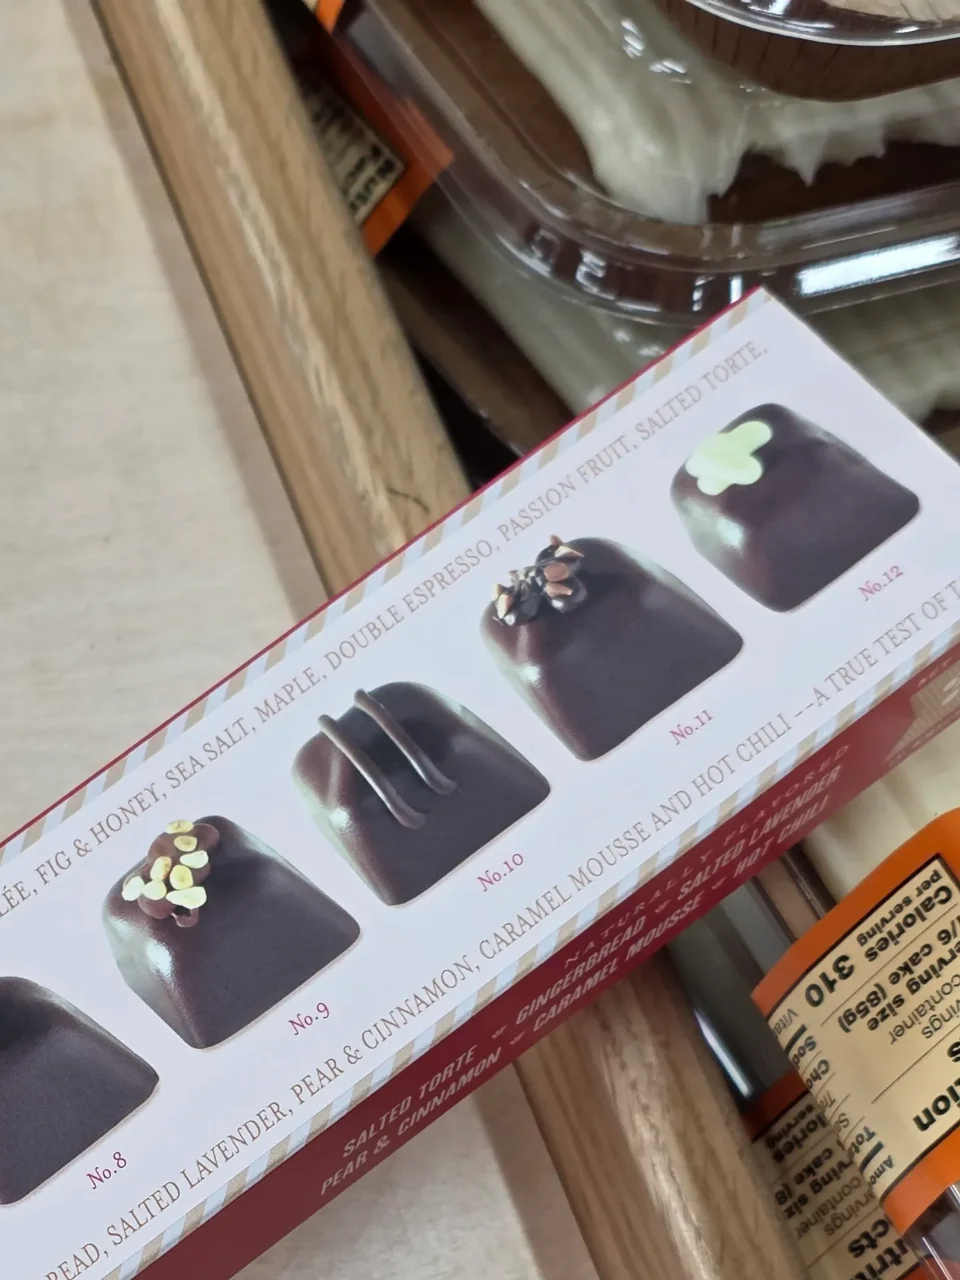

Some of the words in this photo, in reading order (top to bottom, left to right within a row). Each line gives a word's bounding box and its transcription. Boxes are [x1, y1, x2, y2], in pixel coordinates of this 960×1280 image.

[857, 565, 904, 601] No.12
[34, 850, 72, 886] FIG
[72, 838, 92, 857] &
[89, 783, 167, 845] HONEY,
[165, 756, 205, 788] SEA
[202, 718, 256, 762] SALT,
[253, 668, 327, 725] MAPLE,
[324, 608, 404, 671] DOUBLE
[402, 539, 501, 614] ESPRESSO,
[497, 475, 577, 542] PASSION
[576, 436, 639, 484] FRUIT,
[635, 385, 702, 441] SALTED
[699, 341, 768, 397] TORTE,
[668, 709, 713, 745] No.11
[476, 853, 524, 892] No.10
[915, 869, 943, 897] per
[106, 1180, 181, 1246] SALTED
[180, 1101, 294, 1189] LAVENDER,
[290, 1058, 344, 1105] PEAR
[344, 1045, 362, 1065] &
[360, 954, 480, 1050] CINNAMON,
[479, 885, 572, 960] CARAMEL
[569, 822, 651, 891] MOUSSE
[650, 790, 692, 832] AND
[691, 754, 735, 796] HOT
[735, 713, 793, 763] CHILI
[824, 647, 878, 694] TRUE
[873, 613, 921, 657] TEST
[921, 592, 948, 620] OF
[856, 896, 913, 947] serving
[864, 885, 952, 962] Calories
[343, 1096, 412, 1158] SALTED
[418, 1044, 477, 1099] TORTE
[515, 915, 648, 1026] GINGERBREAD
[677, 838, 746, 901] SALTED
[749, 764, 843, 846] LAVENDER
[805, 955, 854, 1007] 310
[888, 943, 933, 986] cake
[288, 1002, 330, 1035] No.9
[320, 1150, 368, 1196] PEAR
[374, 1135, 390, 1155] &
[397, 1047, 502, 1136] CINNAMON
[533, 963, 618, 1032] CARAMEL
[626, 891, 705, 962] MOUSSE
[733, 836, 775, 878] HOT
[838, 982, 888, 1033] (85g)
[867, 994, 905, 1031] size
[86, 1151, 127, 1189] No.8
[793, 1148, 834, 1186] cake
[797, 1176, 862, 1240] container
